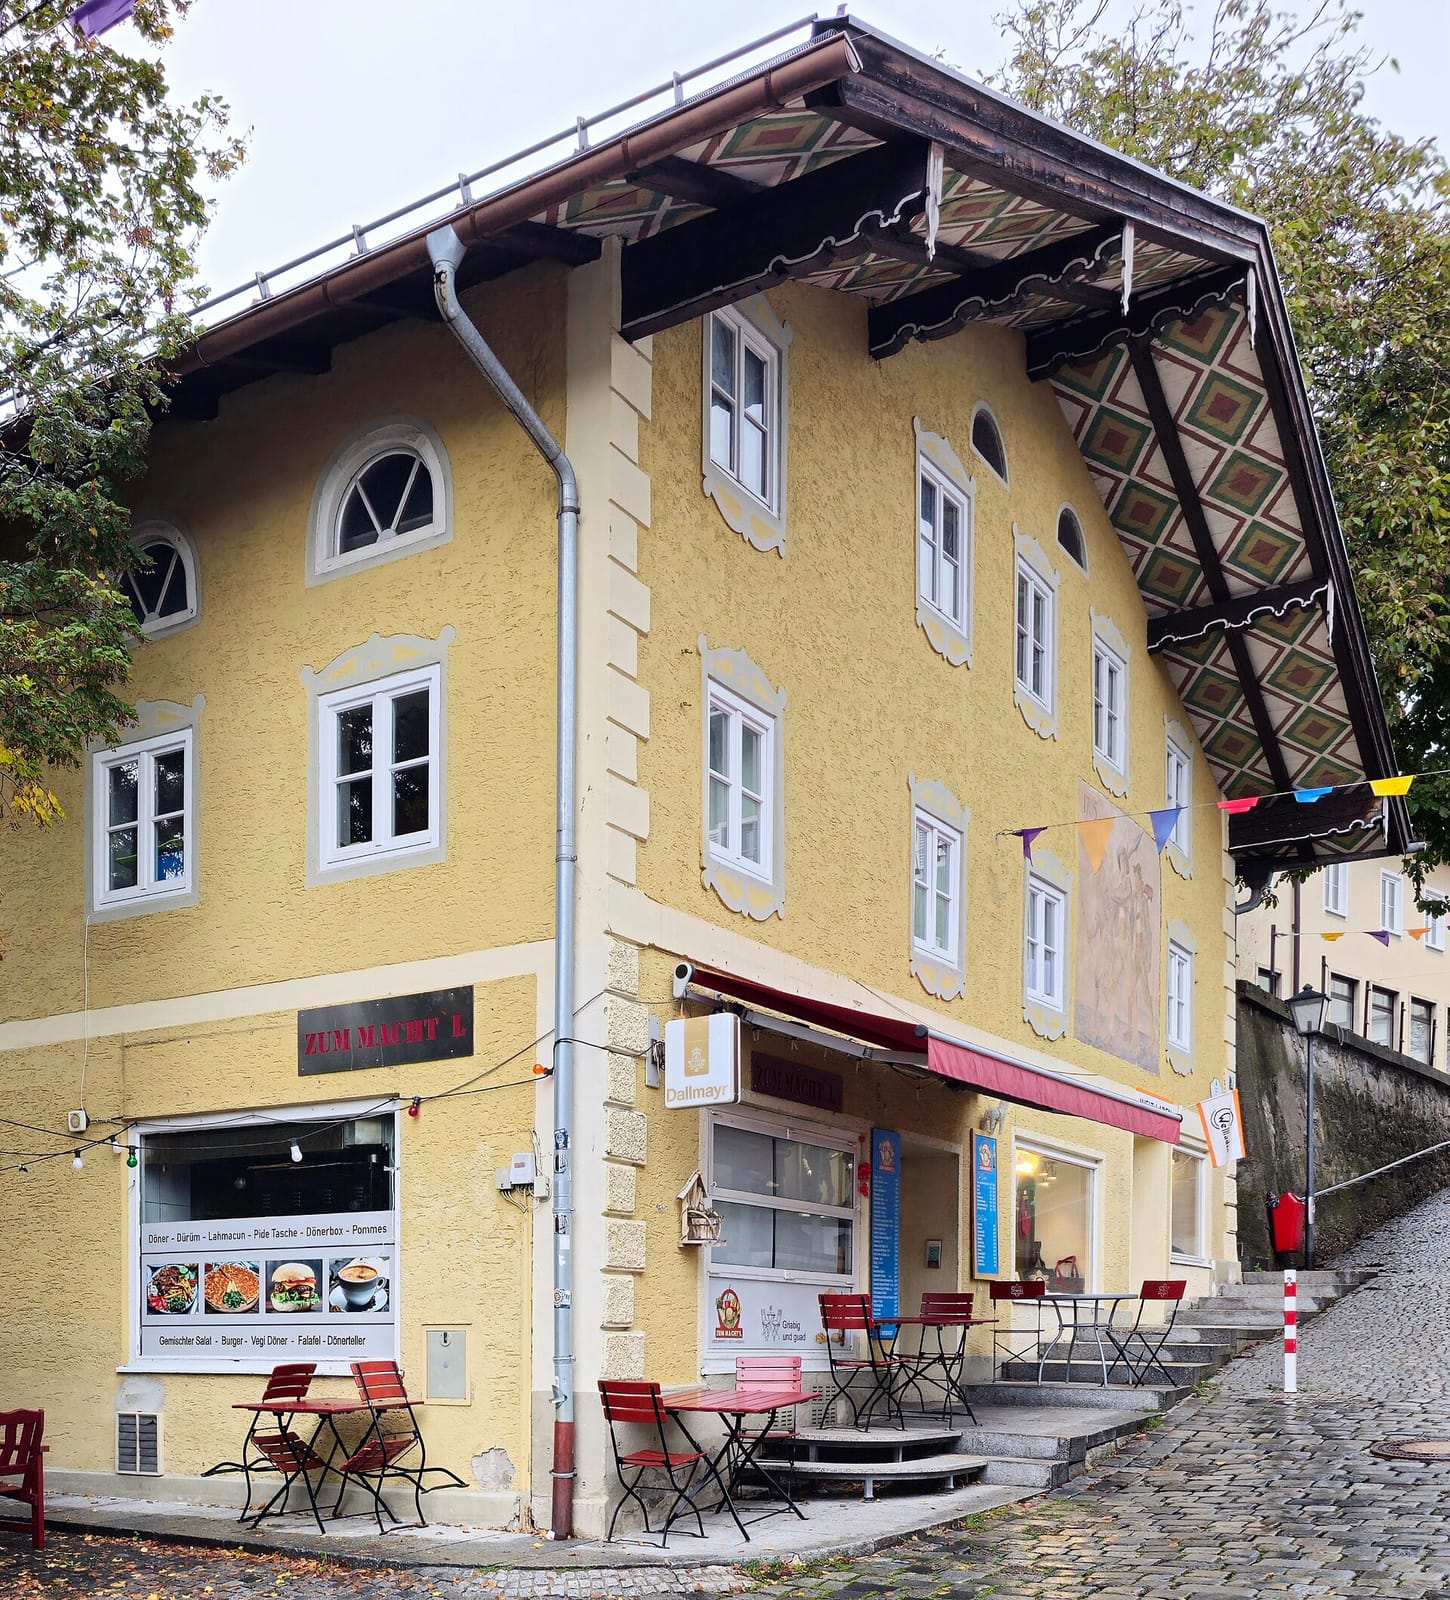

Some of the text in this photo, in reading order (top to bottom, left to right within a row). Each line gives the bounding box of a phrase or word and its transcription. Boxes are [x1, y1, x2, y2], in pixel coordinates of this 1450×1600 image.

[304, 1028, 351, 1056] ZUM
[666, 1085, 728, 1102] Dallmayr
[148, 1233, 170, 1244] Döner
[176, 1232, 201, 1243] Dürüm
[208, 1231, 246, 1241] Lahmacun
[253, 1228, 270, 1239] Pide
[271, 1227, 298, 1239] Tasche
[306, 1225, 344, 1237] Dönerbox
[352, 1224, 388, 1234] Pommes
[159, 1336, 195, 1346] Gemischter
[195, 1336, 212, 1346] Salat
[221, 1335, 243, 1348] Burger
[251, 1335, 266, 1348] Vegi
[267, 1335, 288, 1346] Döner
[298, 1335, 321, 1346] Falafel
[327, 1335, 367, 1346] Dönerteller
[782, 1333, 793, 1341] und
